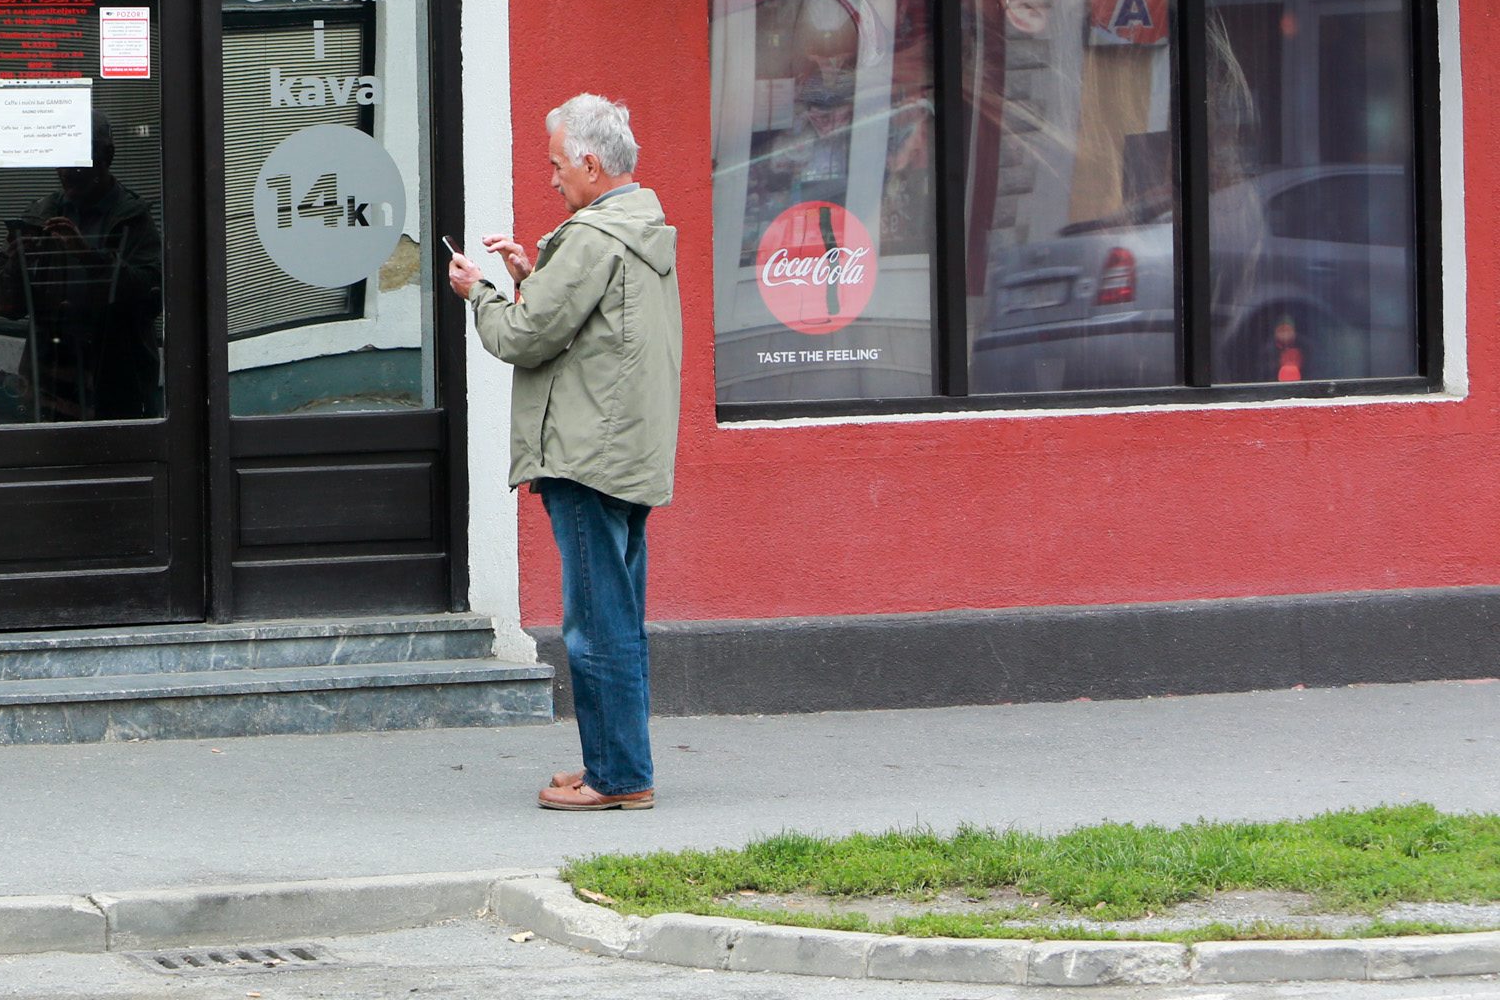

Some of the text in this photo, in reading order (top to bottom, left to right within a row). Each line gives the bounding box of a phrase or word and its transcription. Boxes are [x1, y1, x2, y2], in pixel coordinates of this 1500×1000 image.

[313, 20, 325, 59] i
[270, 68, 382, 108] kava
[762, 247, 869, 287] Coca-Cola
[757, 348, 879, 363] TASTE THE FEELING
